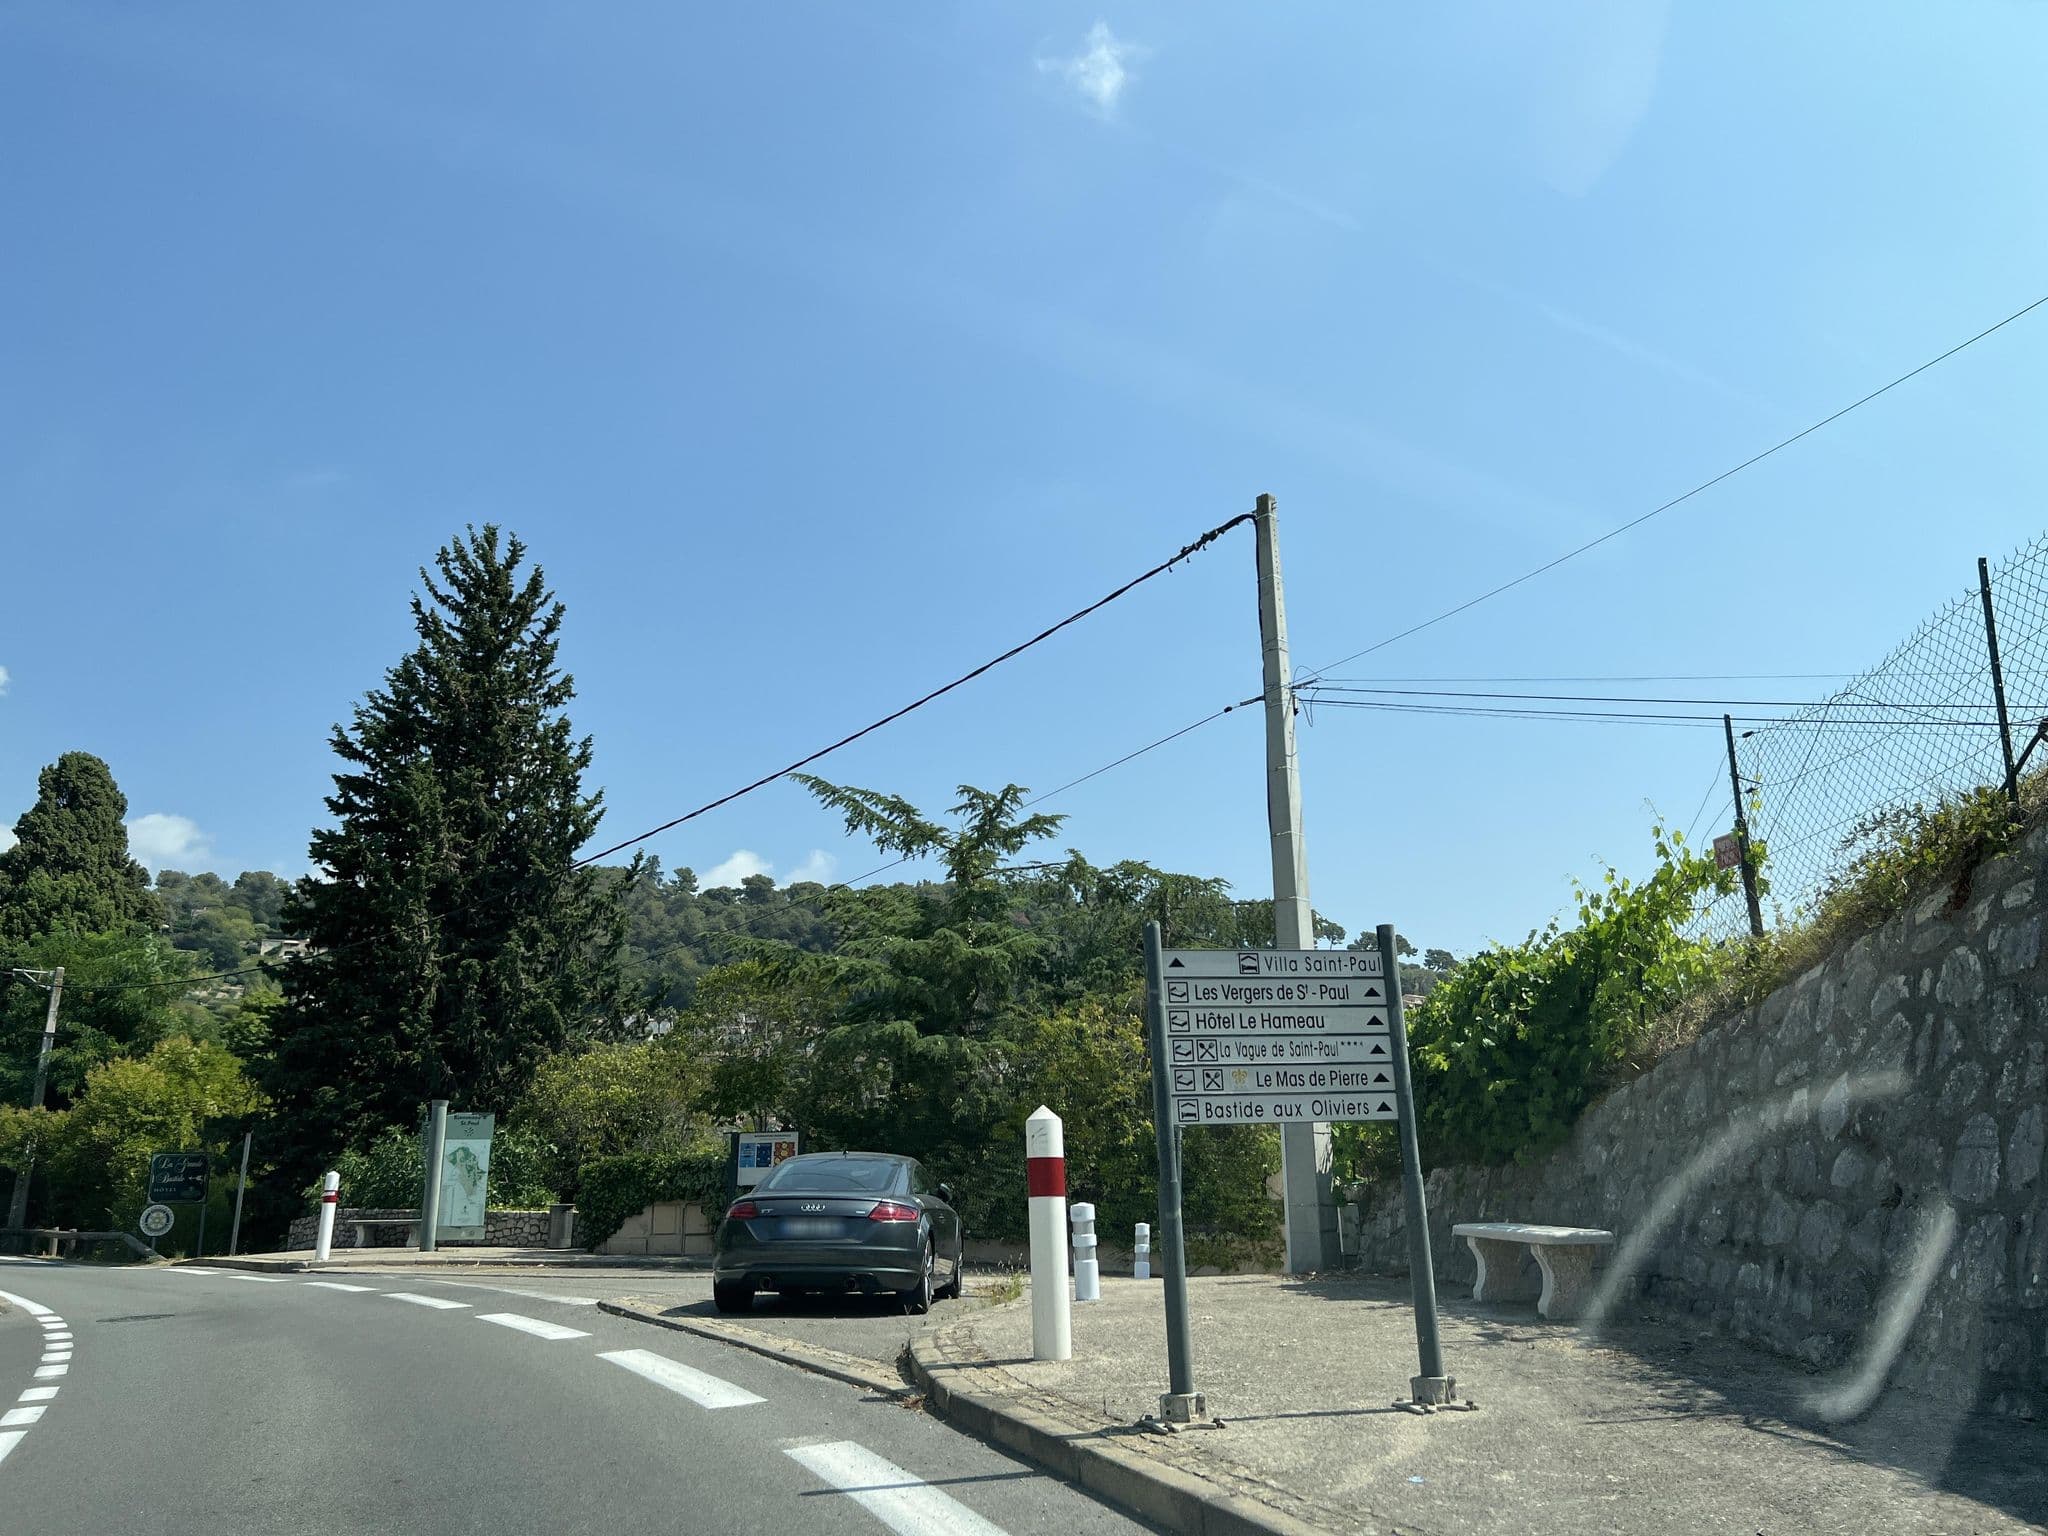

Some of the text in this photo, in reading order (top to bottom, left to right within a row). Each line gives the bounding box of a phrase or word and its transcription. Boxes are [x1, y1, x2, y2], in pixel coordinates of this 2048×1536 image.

[1264, 956, 1382, 972] Villa Saint-Paul
[1194, 984, 1218, 1000] Les
[1221, 984, 1273, 1004] Vergers
[1277, 984, 1293, 1001] de
[1196, 1013, 1325, 1029] Hôtel Le Hameau
[1219, 1042, 1230, 1057] La
[1235, 1042, 1266, 1061] Vague
[1272, 1041, 1284, 1057] de
[1256, 1070, 1368, 1087] Le Mas de Pierre
[1206, 1100, 1369, 1119] Bastide aux Oliviers
